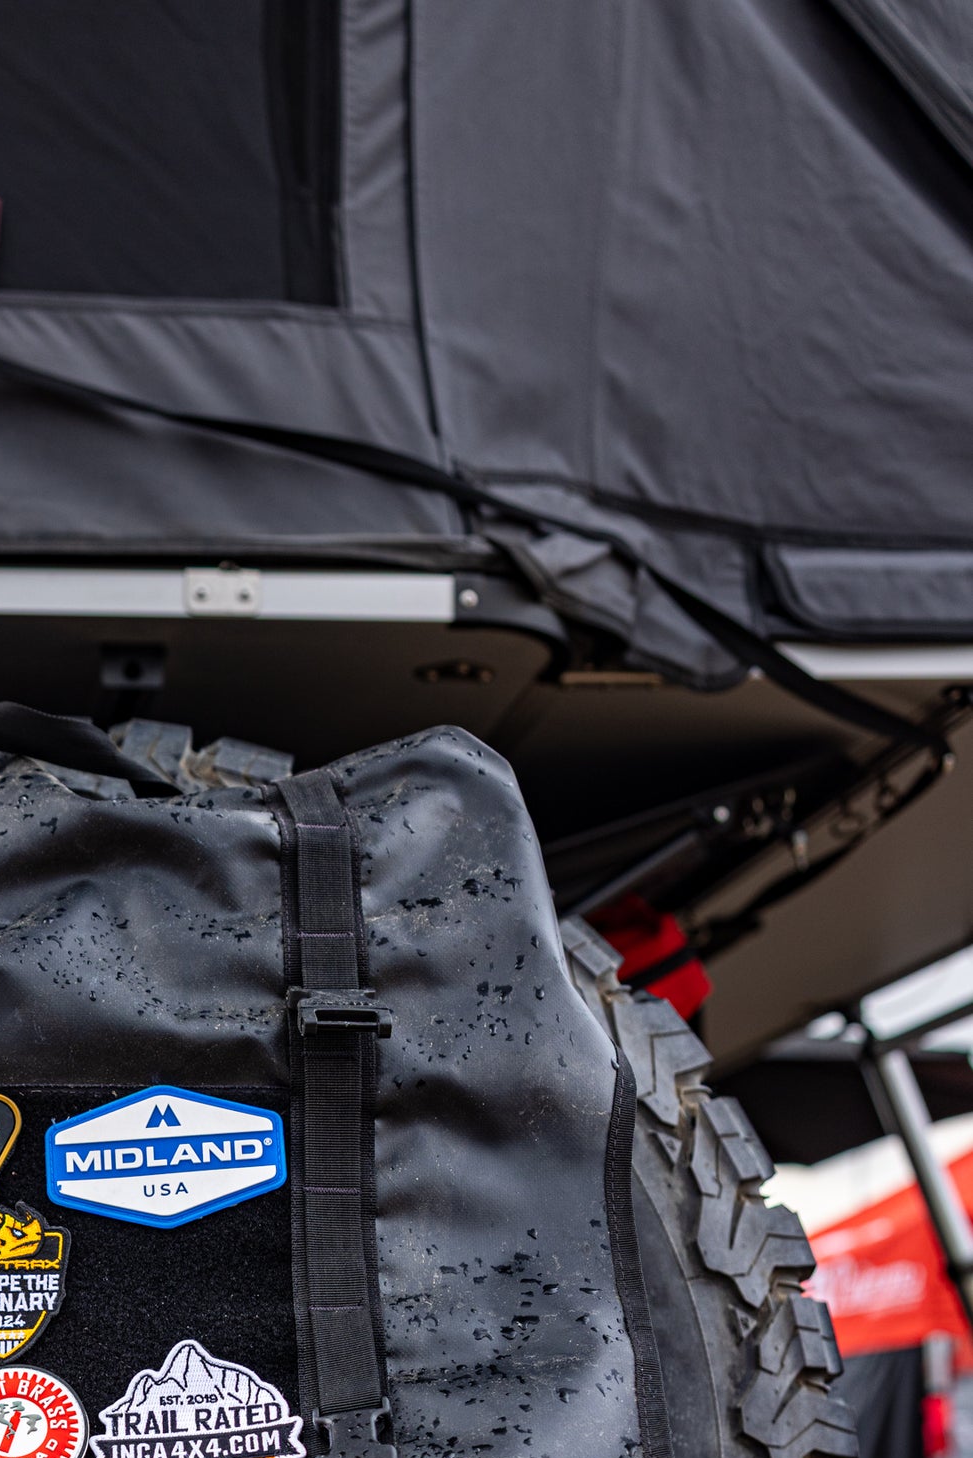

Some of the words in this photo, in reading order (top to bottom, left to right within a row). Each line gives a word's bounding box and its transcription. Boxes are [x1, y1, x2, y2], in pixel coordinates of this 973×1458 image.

[143, 1182, 189, 1197] USA
[23, 1274, 60, 1291] THE
[16, 1379, 68, 1429] BRASS
[159, 1395, 184, 1406] EST.
[186, 1393, 218, 1404] 2019
[105, 1410, 189, 1437] TRAIL
[194, 1402, 282, 1432] RATED
